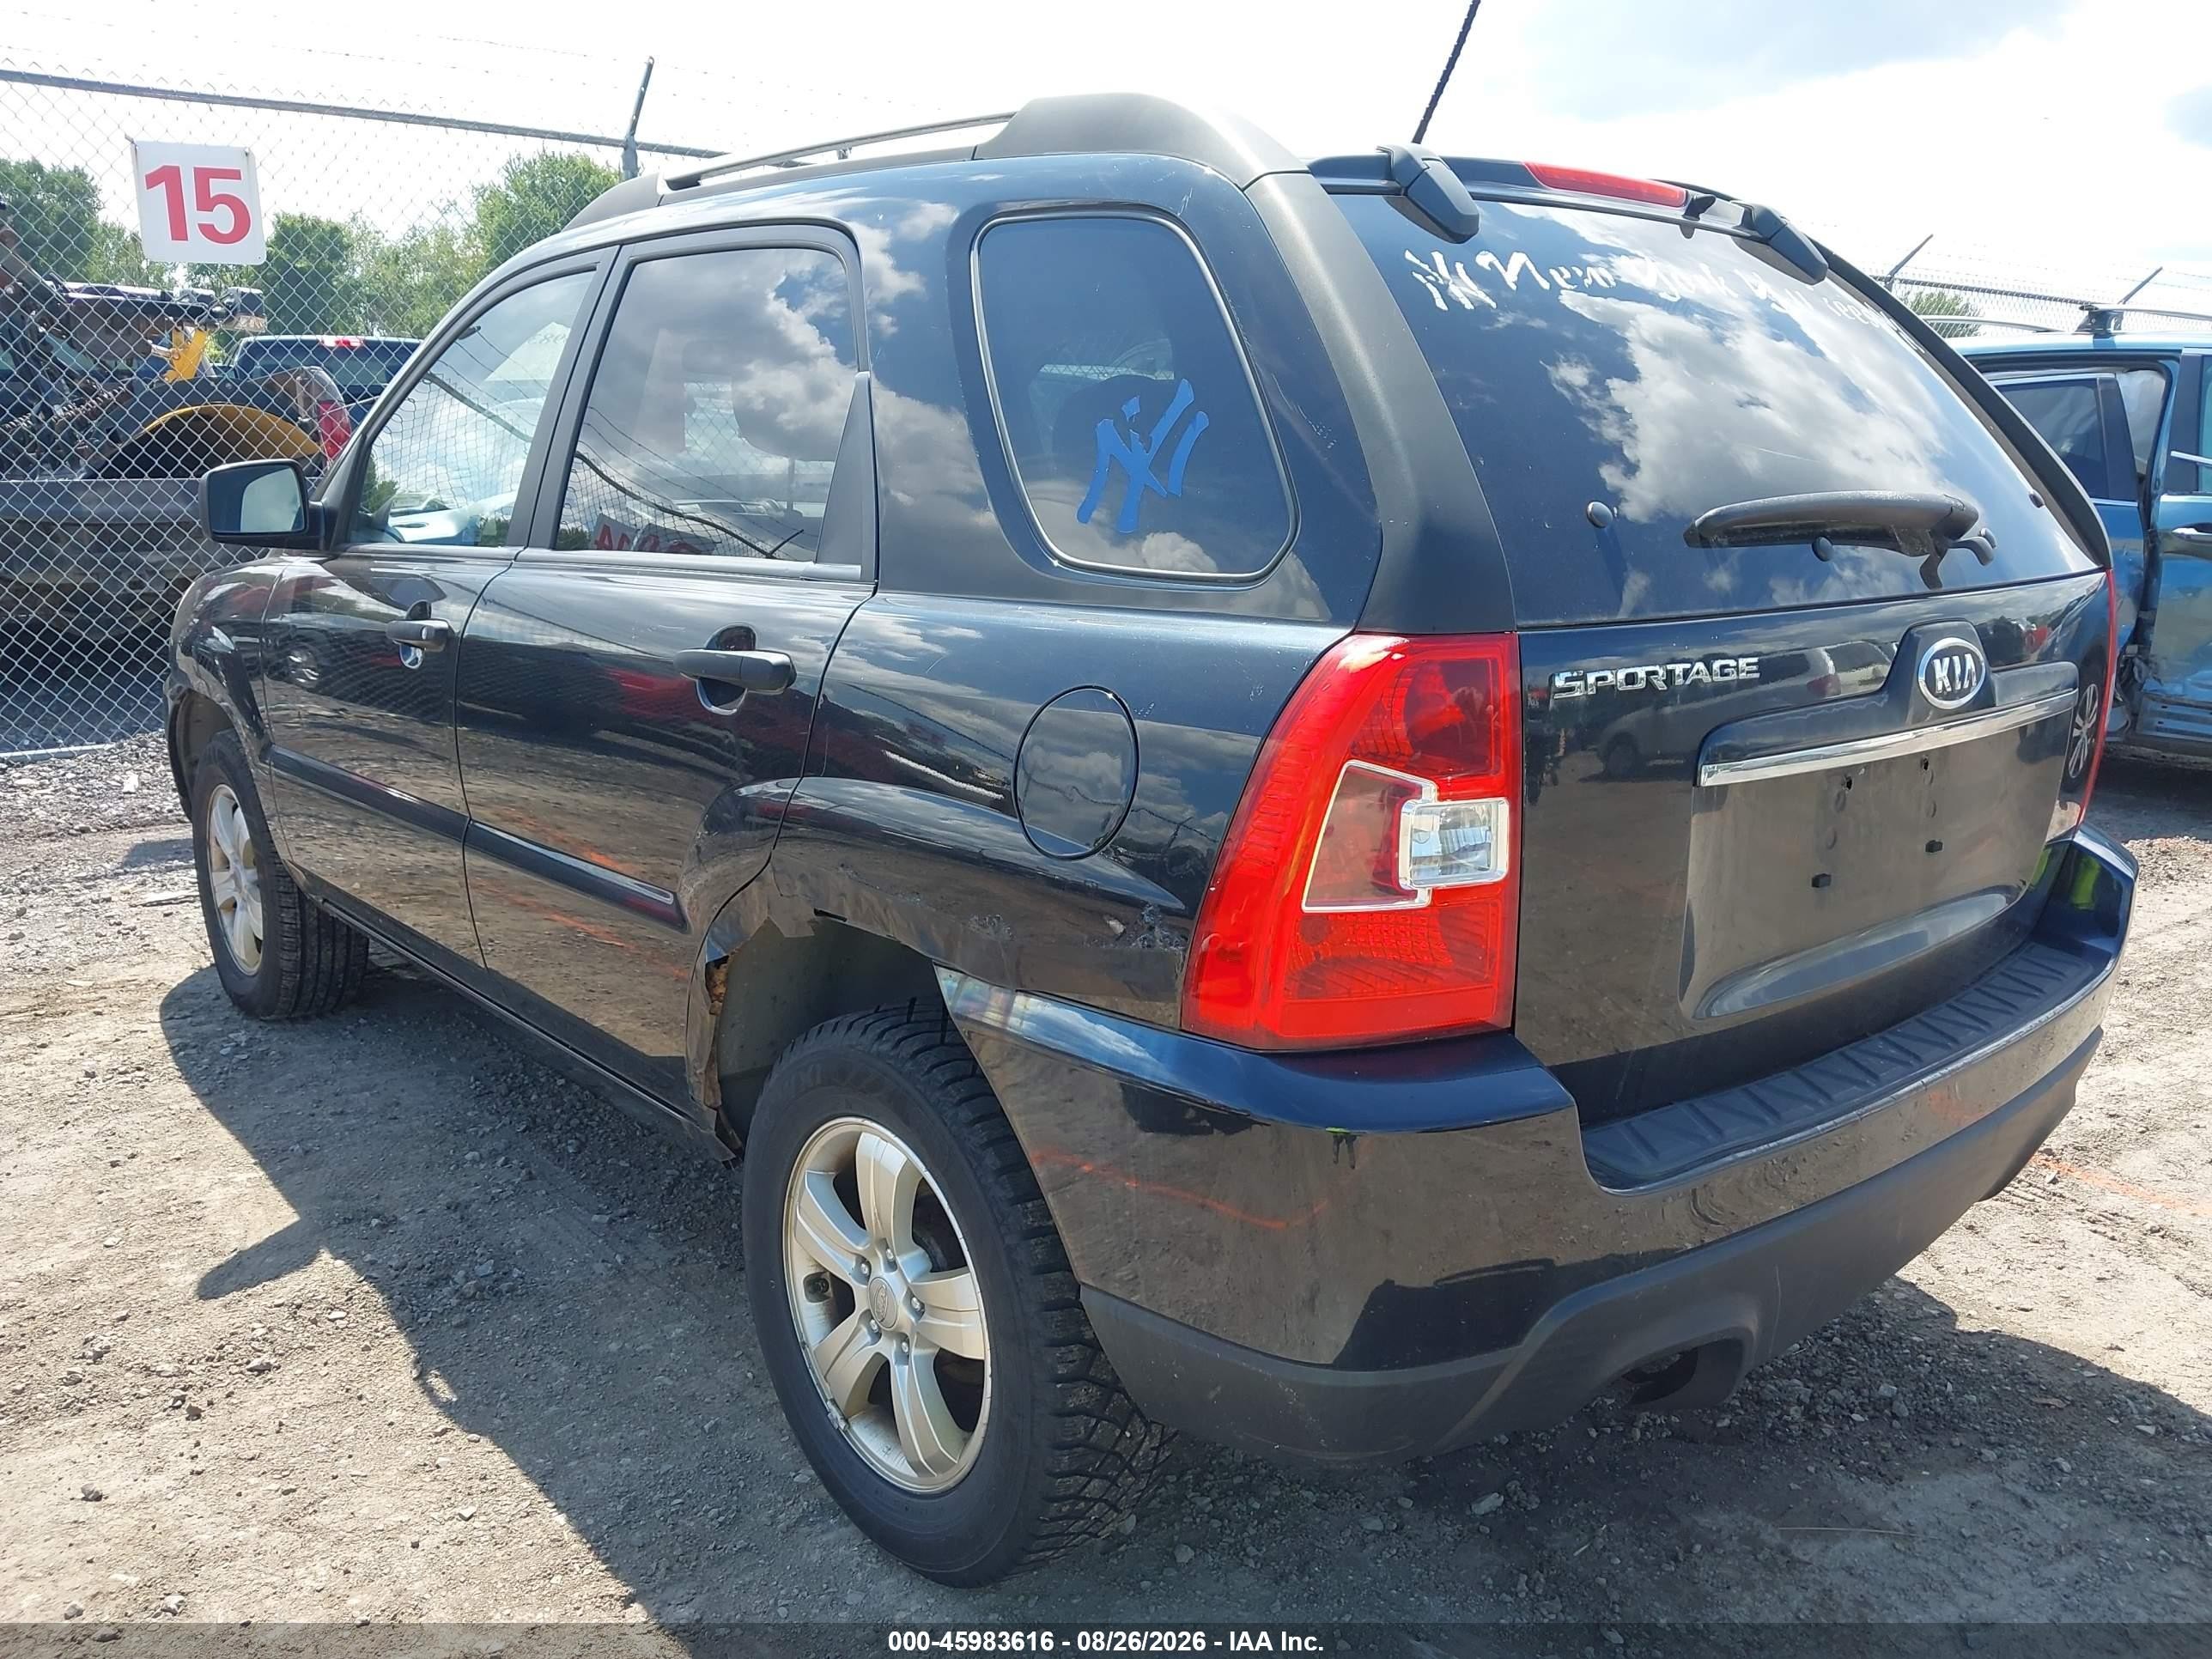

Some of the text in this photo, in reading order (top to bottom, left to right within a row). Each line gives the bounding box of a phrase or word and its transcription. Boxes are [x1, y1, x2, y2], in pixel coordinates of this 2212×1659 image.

[144, 164, 252, 245] 15
[1474, 250, 1616, 290] New
[1552, 656, 1762, 700] SPORTAGE
[1932, 653, 1978, 694] KIA
